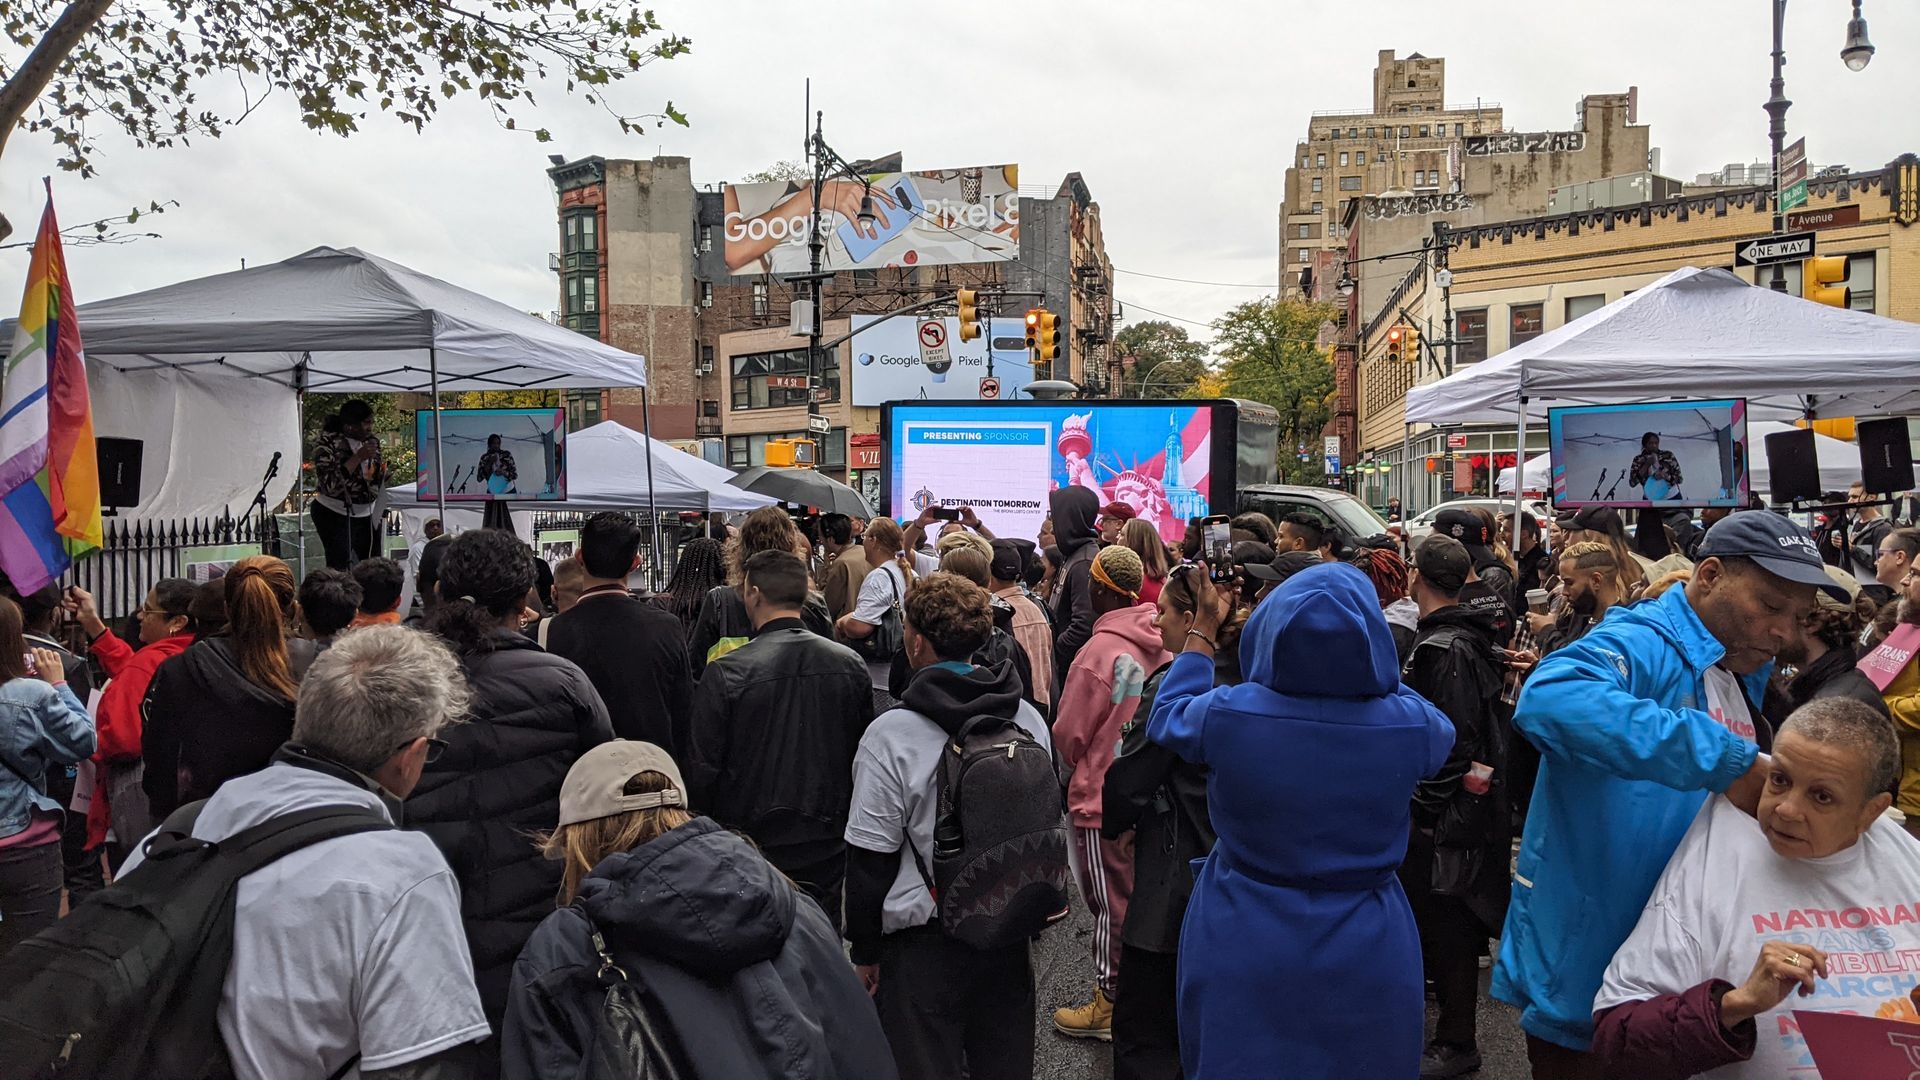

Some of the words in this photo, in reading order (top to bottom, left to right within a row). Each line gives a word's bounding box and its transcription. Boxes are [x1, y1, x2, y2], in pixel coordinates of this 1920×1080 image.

[724, 207, 836, 246] Google
[922, 195, 996, 231] Pixel
[1004, 193, 1019, 224] 8
[1789, 216, 1795, 226] 7
[1798, 213, 1834, 225] Avenue
[1749, 245, 1774, 258] ONE
[1780, 241, 1805, 254] WAY
[880, 354, 920, 367] Google
[958, 355, 983, 366] Pixel
[776, 377, 782, 387] W
[784, 378, 789, 387] 4
[790, 379, 797, 387] St
[923, 431, 982, 440] PRESENTING
[984, 432, 1029, 441] SPONSOR
[1327, 446, 1338, 454] 20
[1484, 453, 1517, 469] CVS
[941, 498, 992, 507] DESTINATION
[993, 499, 1041, 509] TOMORROW
[1876, 644, 1910, 663] TRANS
[1811, 974, 1917, 999] ARCH
